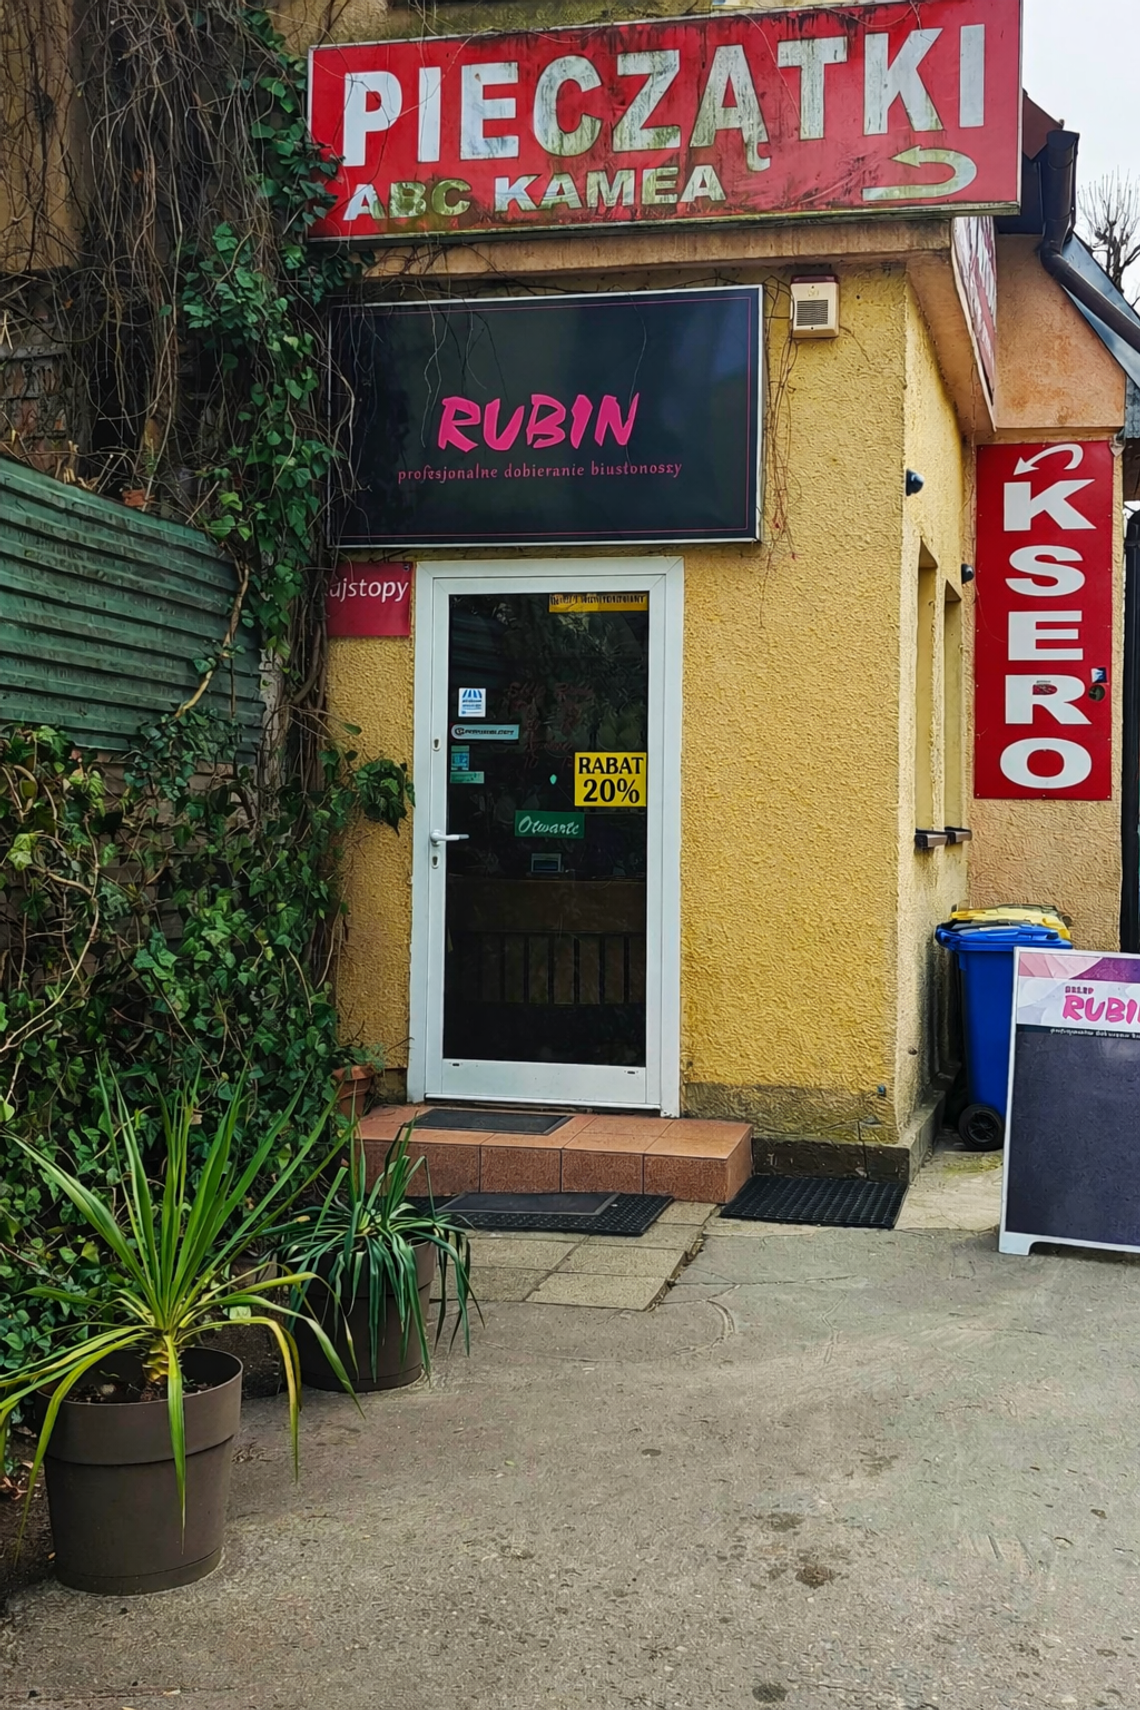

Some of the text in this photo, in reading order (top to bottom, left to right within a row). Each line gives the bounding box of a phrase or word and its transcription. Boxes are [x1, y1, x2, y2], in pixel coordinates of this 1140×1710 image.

[342, 24, 985, 172] PIECZĄTKI
[343, 165, 726, 221] ABC KAMEA
[438, 392, 640, 452] RUBIN
[398, 461, 682, 484] profesjonalne dobieranie biustonoszy
[324, 577, 409, 603] ajstopy
[1000, 479, 1097, 789] KSERO
[578, 756, 644, 775] RABAT
[583, 778, 640, 804] 20%
[1062, 995, 1140, 1025] RUBI
